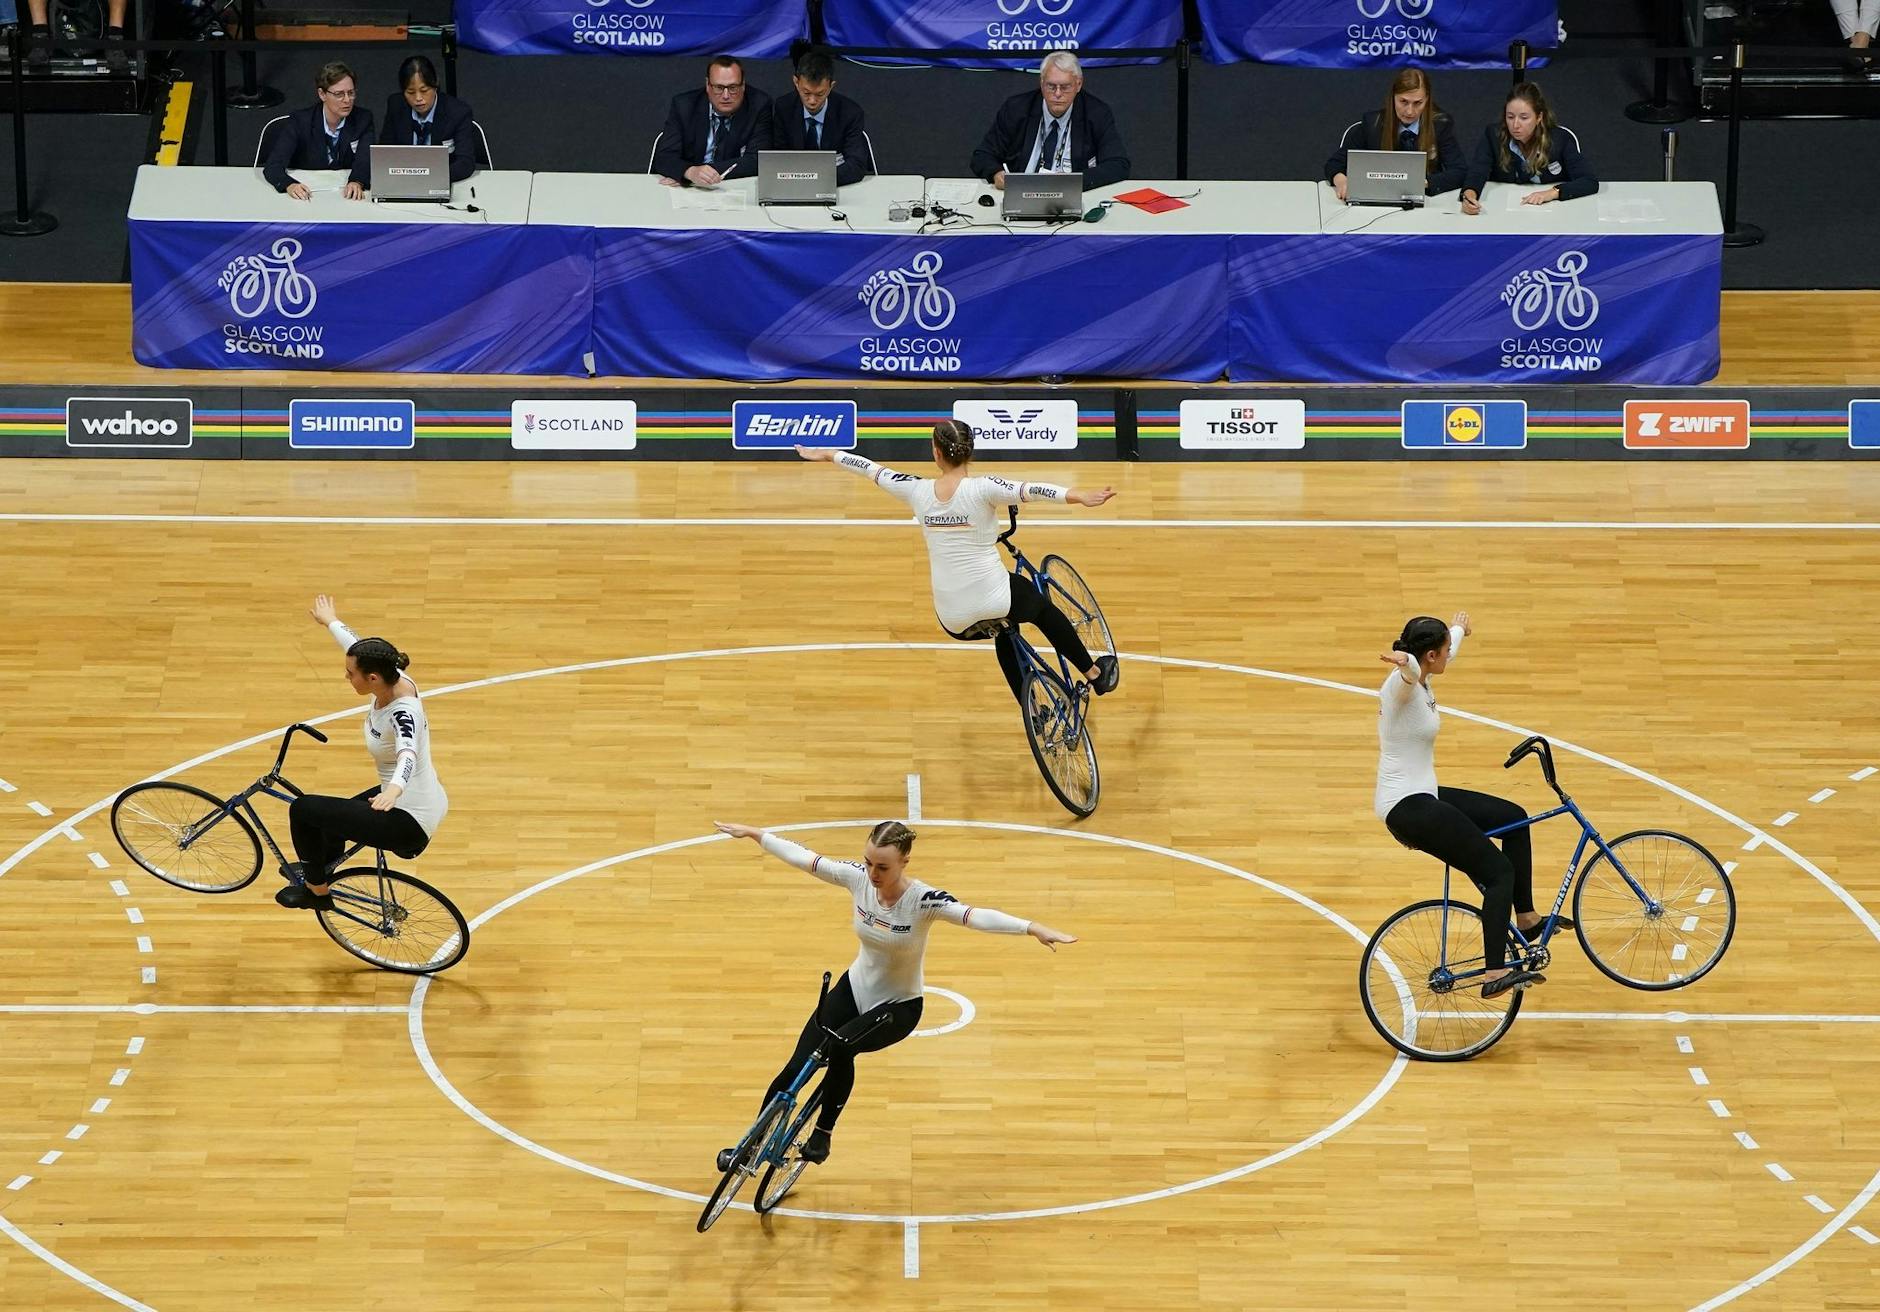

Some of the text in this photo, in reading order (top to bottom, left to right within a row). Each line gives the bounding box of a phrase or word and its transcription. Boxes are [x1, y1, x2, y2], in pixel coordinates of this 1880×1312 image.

[572, 14, 665, 29] GLASGOW
[987, 22, 1080, 38] GLASGOW
[573, 30, 665, 46] SCOTLAND
[1347, 24, 1438, 42] GLASGOW
[987, 39, 1080, 50] SCOTLAND
[1347, 40, 1437, 56] SCOTLAND
[218, 255, 248, 292] 2023
[858, 270, 889, 306] 2023
[1500, 270, 1532, 306] 2023
[223, 323, 324, 342] GLASGOW
[224, 339, 325, 359] SCOTLAND
[860, 337, 962, 354] GLASGOW
[1501, 337, 1603, 354] GLASGOW
[860, 355, 962, 372] SCOTLAND
[1500, 354, 1602, 371] SCOTLAND
[81, 410, 178, 436] wahoo
[301, 416, 403, 432] SHIMANO
[538, 419, 624, 431] SCOTLAND
[745, 414, 844, 436] Santini
[1206, 421, 1279, 434] TISSOT
[1669, 416, 1736, 433] ZWIFT
[972, 427, 1058, 442] Peter Vardy
[924, 515, 969, 525] GERMANY
[393, 710, 416, 739] KTM
[1551, 863, 1576, 916] WALTHER
